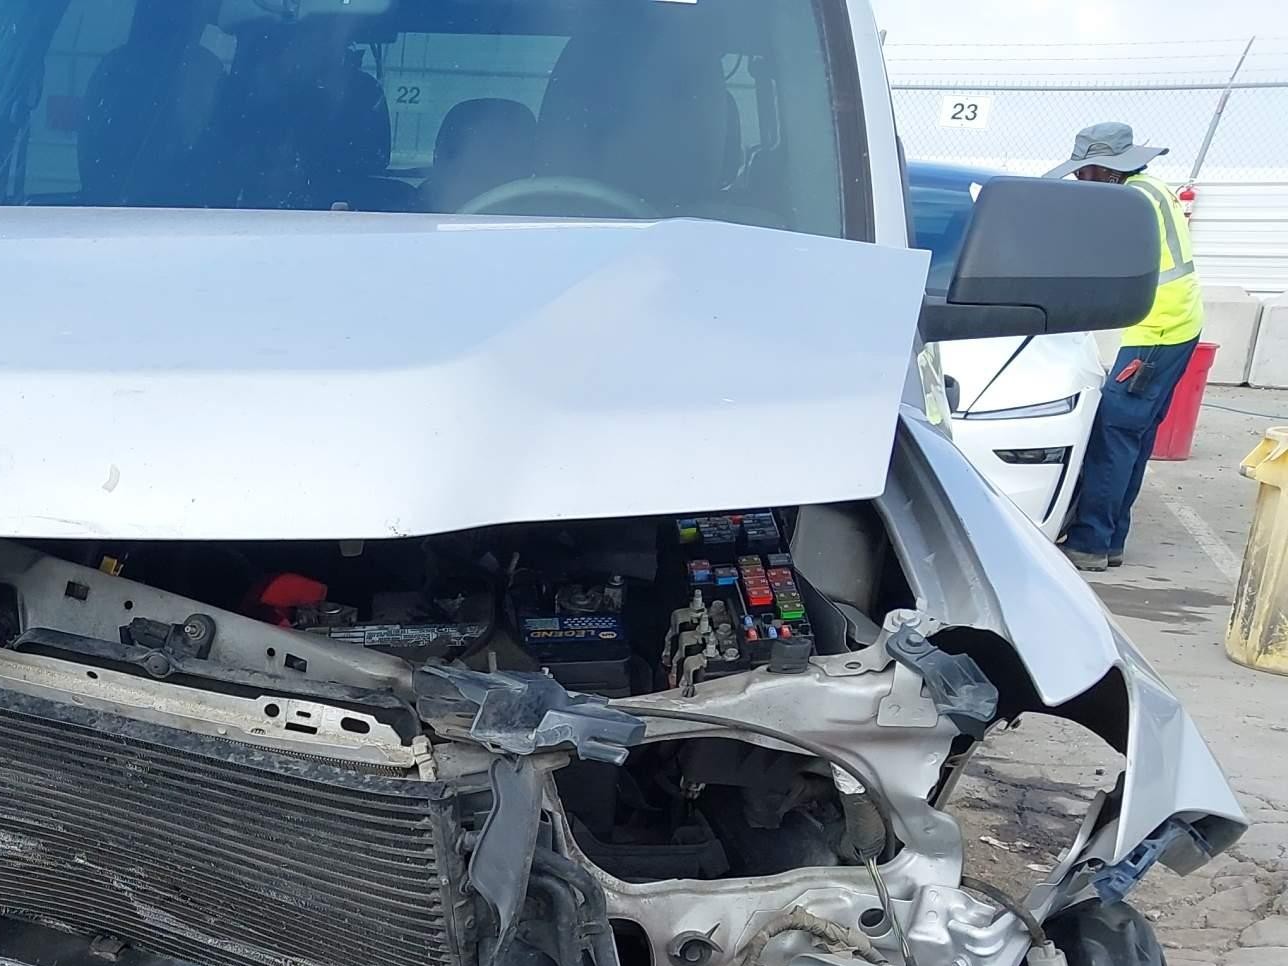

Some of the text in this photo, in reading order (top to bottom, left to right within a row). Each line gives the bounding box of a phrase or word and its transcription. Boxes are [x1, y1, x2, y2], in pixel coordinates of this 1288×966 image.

[396, 86, 421, 104] 22
[950, 102, 979, 121] 23
[530, 630, 596, 638] LEGEND
